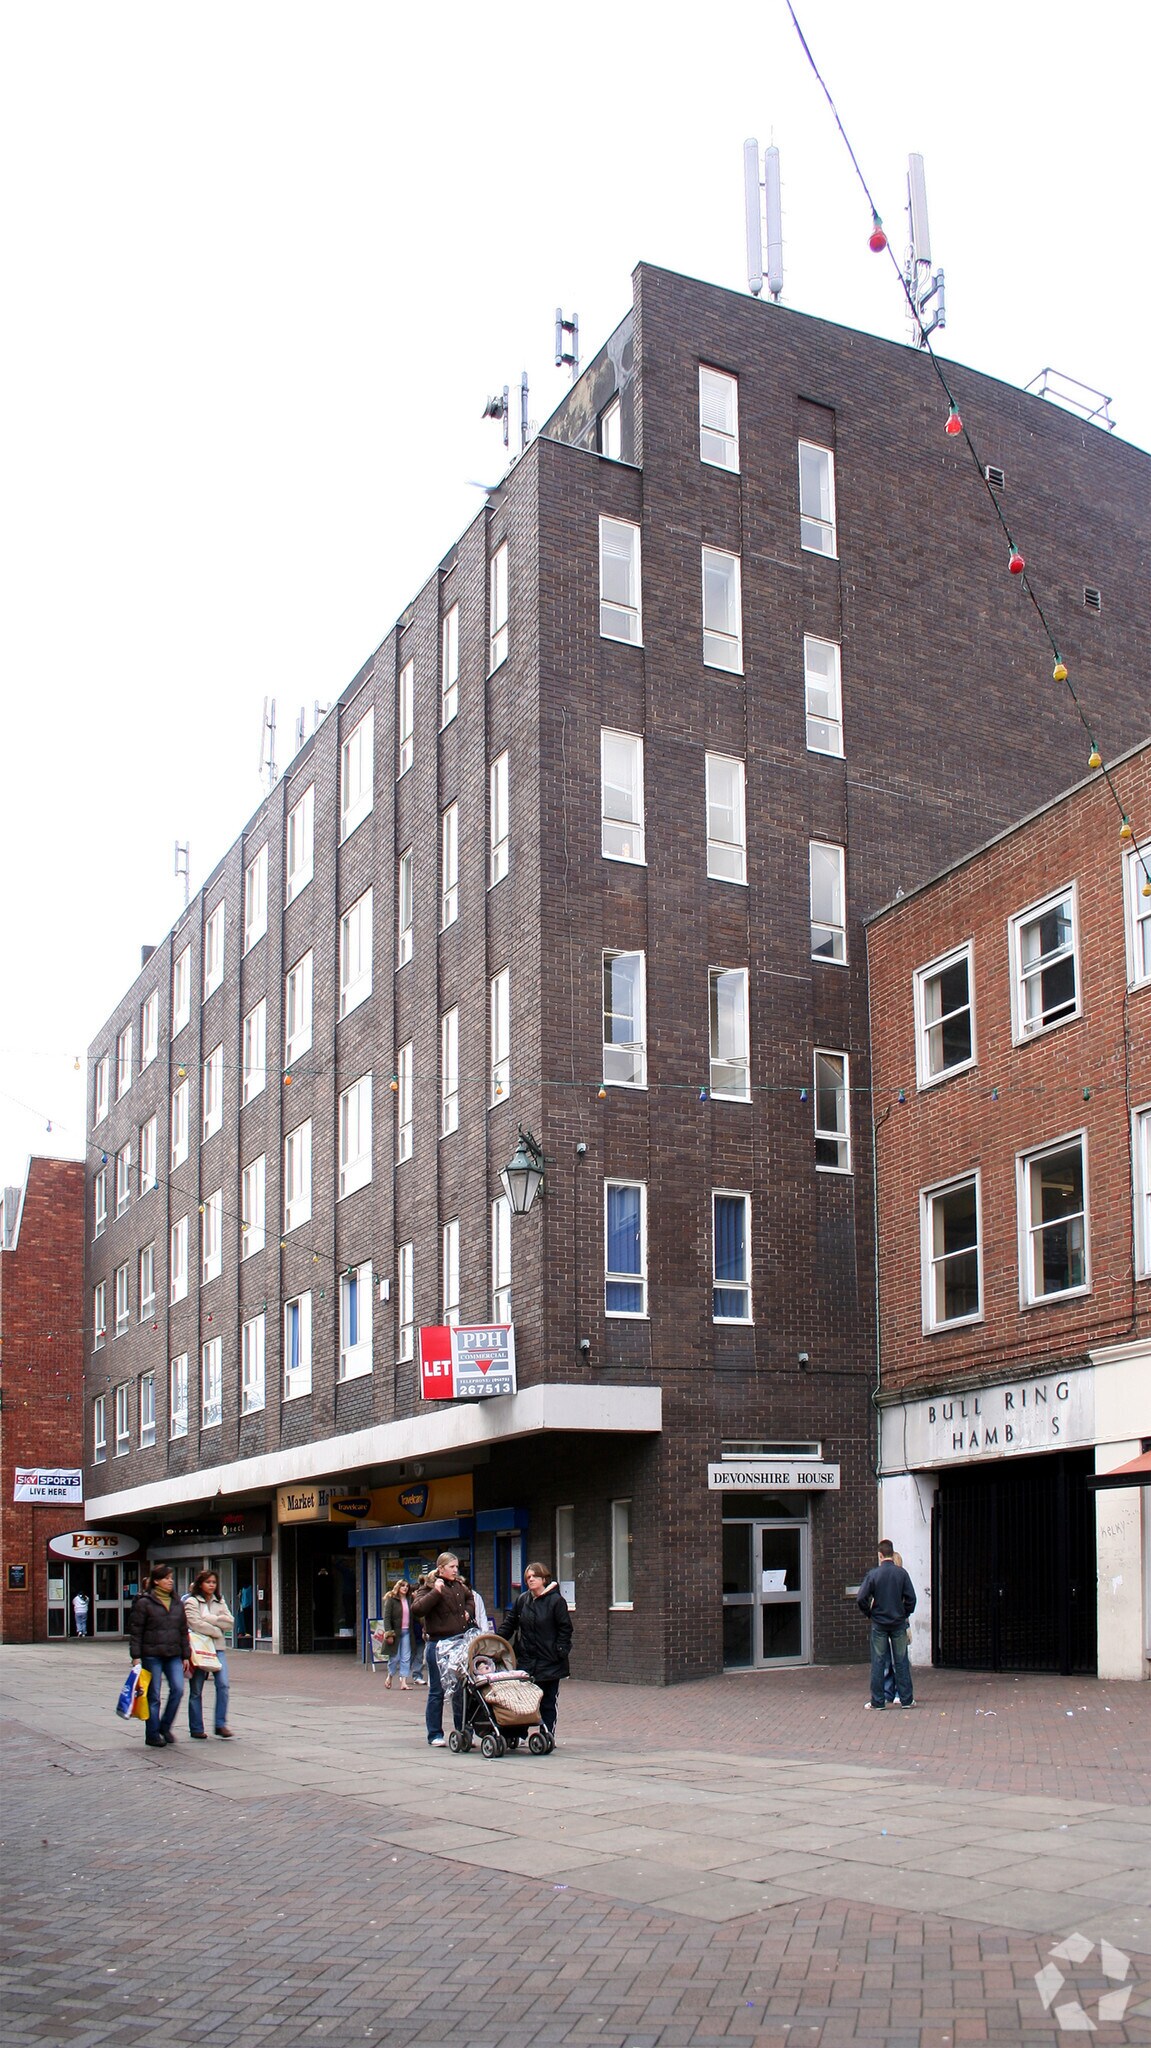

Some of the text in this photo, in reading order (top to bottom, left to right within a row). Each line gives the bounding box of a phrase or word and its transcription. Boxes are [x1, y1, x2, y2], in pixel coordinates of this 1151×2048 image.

[463, 1332, 501, 1348] PPH
[424, 1360, 451, 1377] LET
[460, 1383, 511, 1395] 267513
[928, 1382, 1069, 1423] BULL RING
[17, 1475, 80, 1486] SKY SPORTS
[713, 1472, 835, 1484] DEVONSHIRE HOUSE
[29, 1487, 67, 1496] LIVE HERE
[287, 1493, 315, 1511] Market
[400, 1492, 425, 1506] Travelcare
[338, 1503, 368, 1511] Travelcare
[72, 1533, 119, 1548] PEPYS
